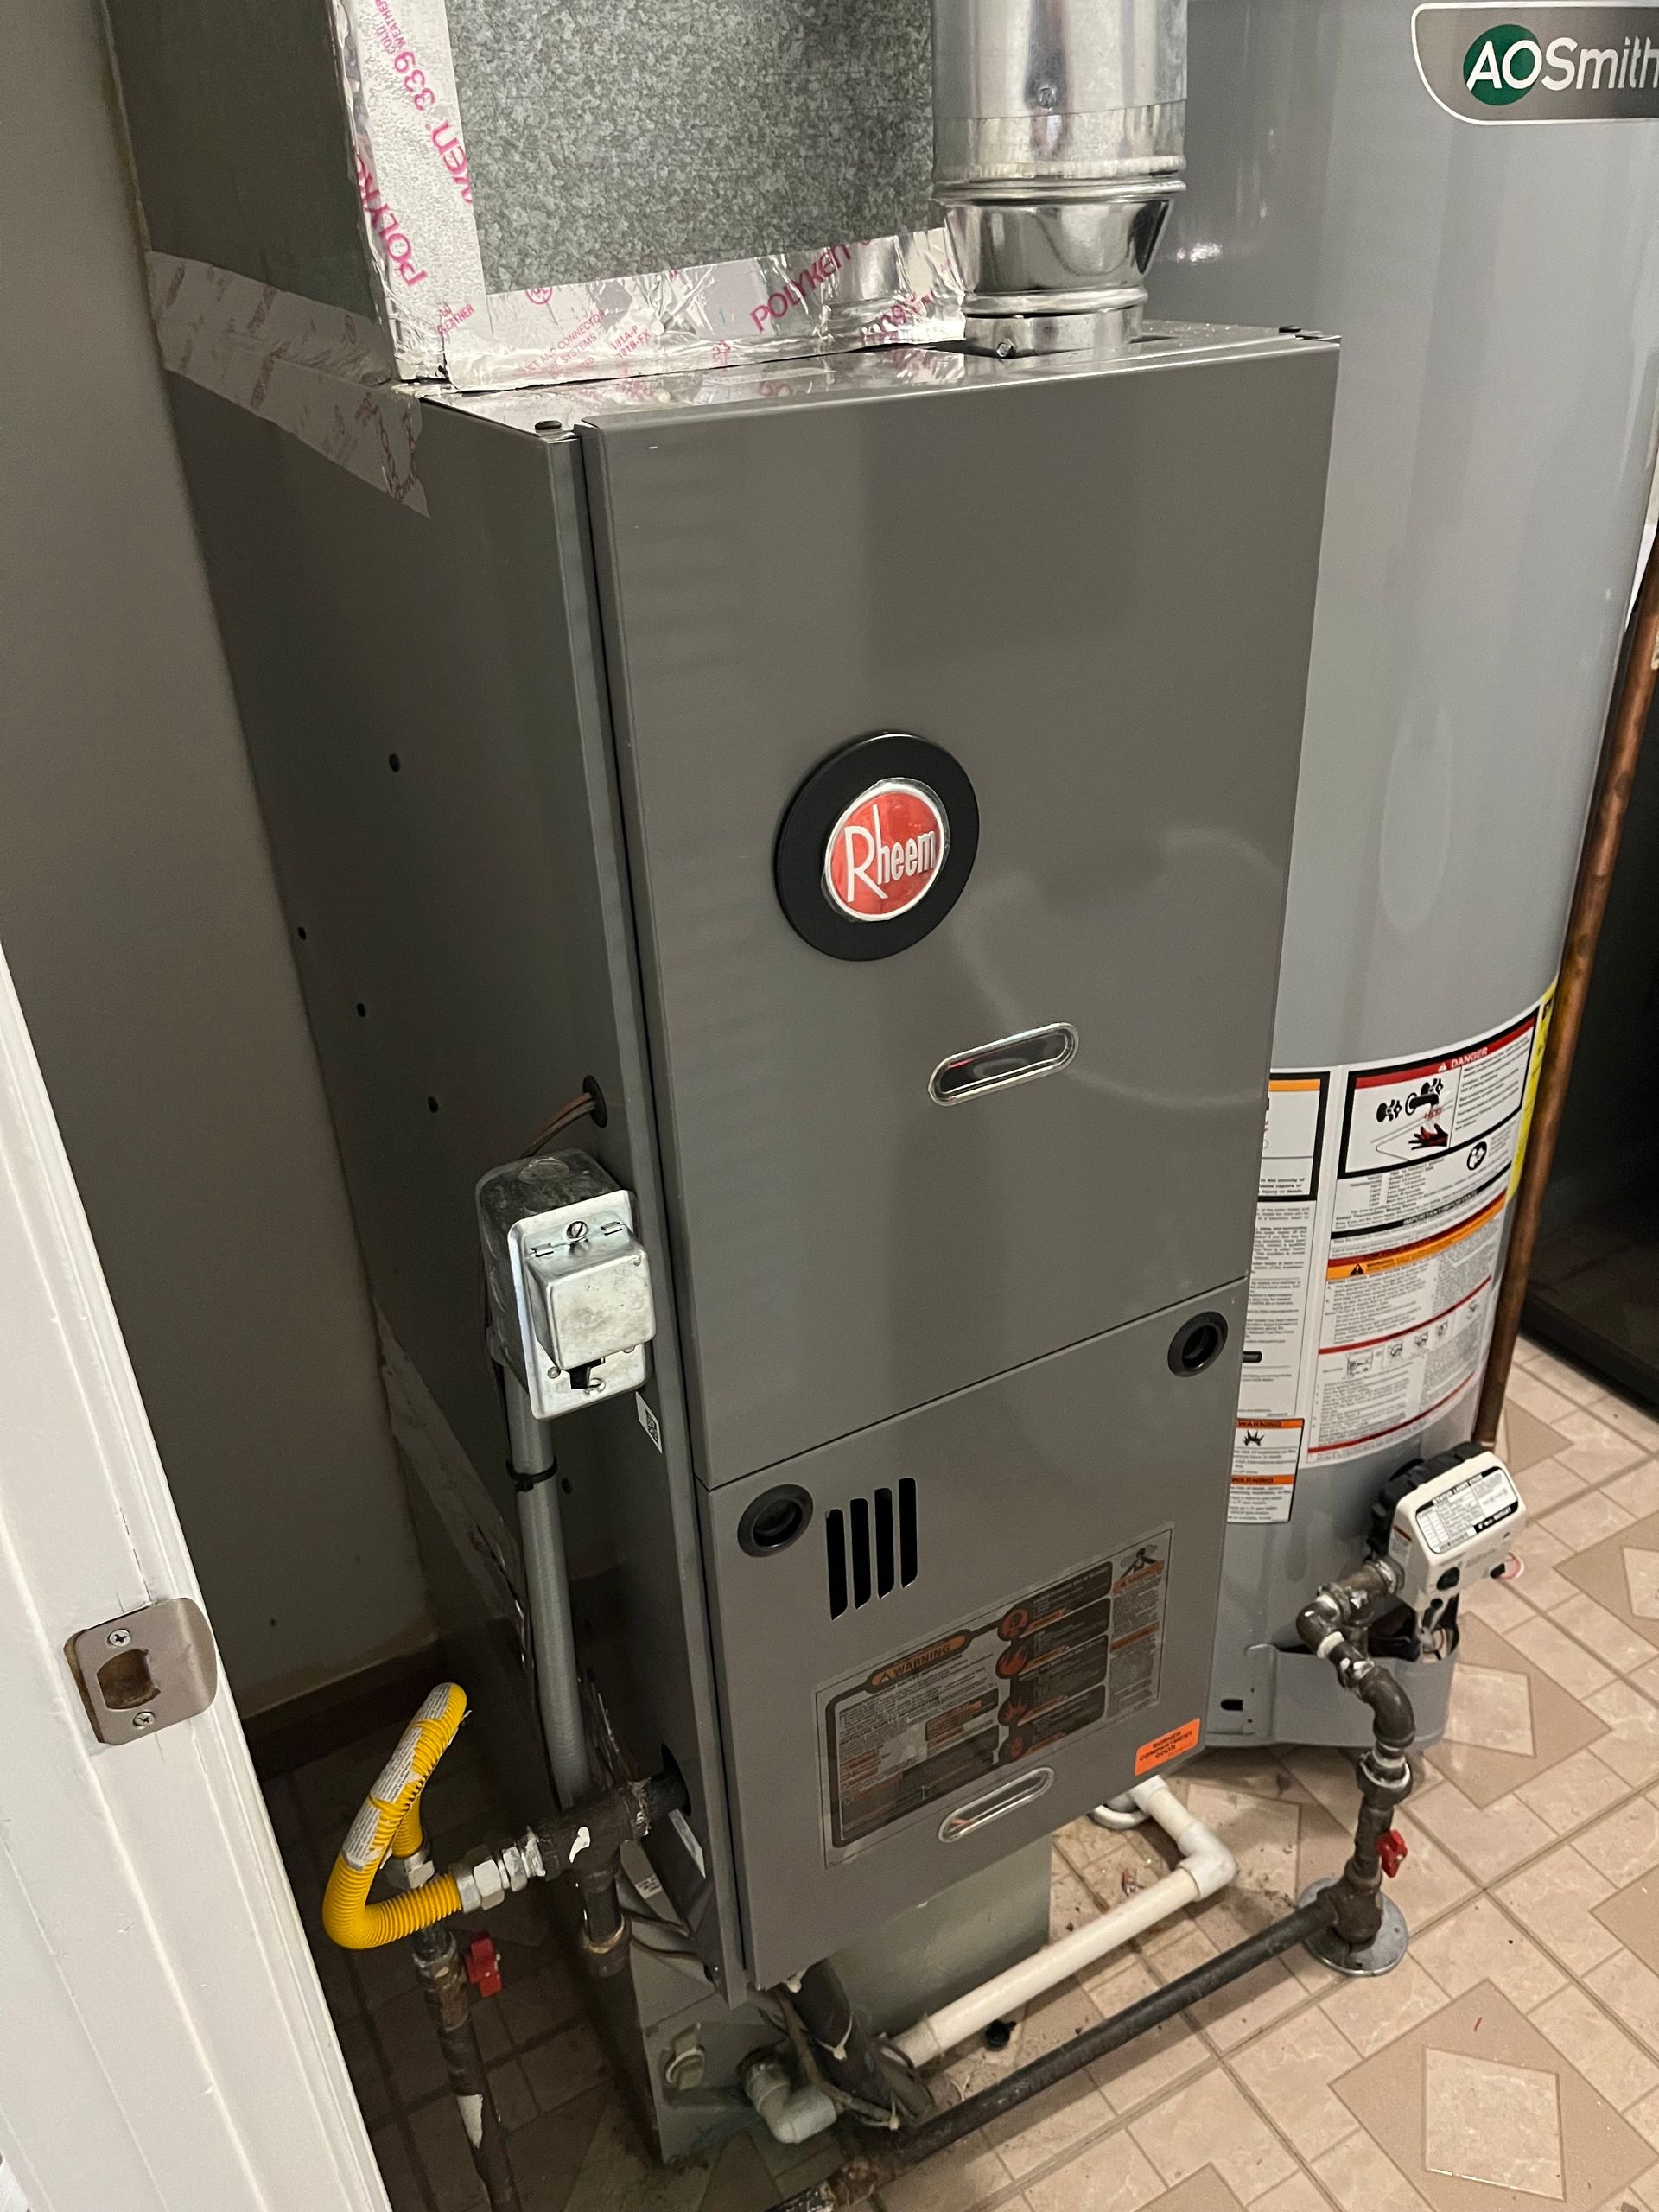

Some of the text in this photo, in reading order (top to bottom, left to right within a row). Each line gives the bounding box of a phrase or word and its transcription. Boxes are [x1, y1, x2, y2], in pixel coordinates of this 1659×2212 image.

[394, 51, 435, 111] 339
[843, 804, 937, 903] Rheem
[1451, 1046, 1488, 1069] DANGER
[894, 1646, 950, 1675] WARNING
